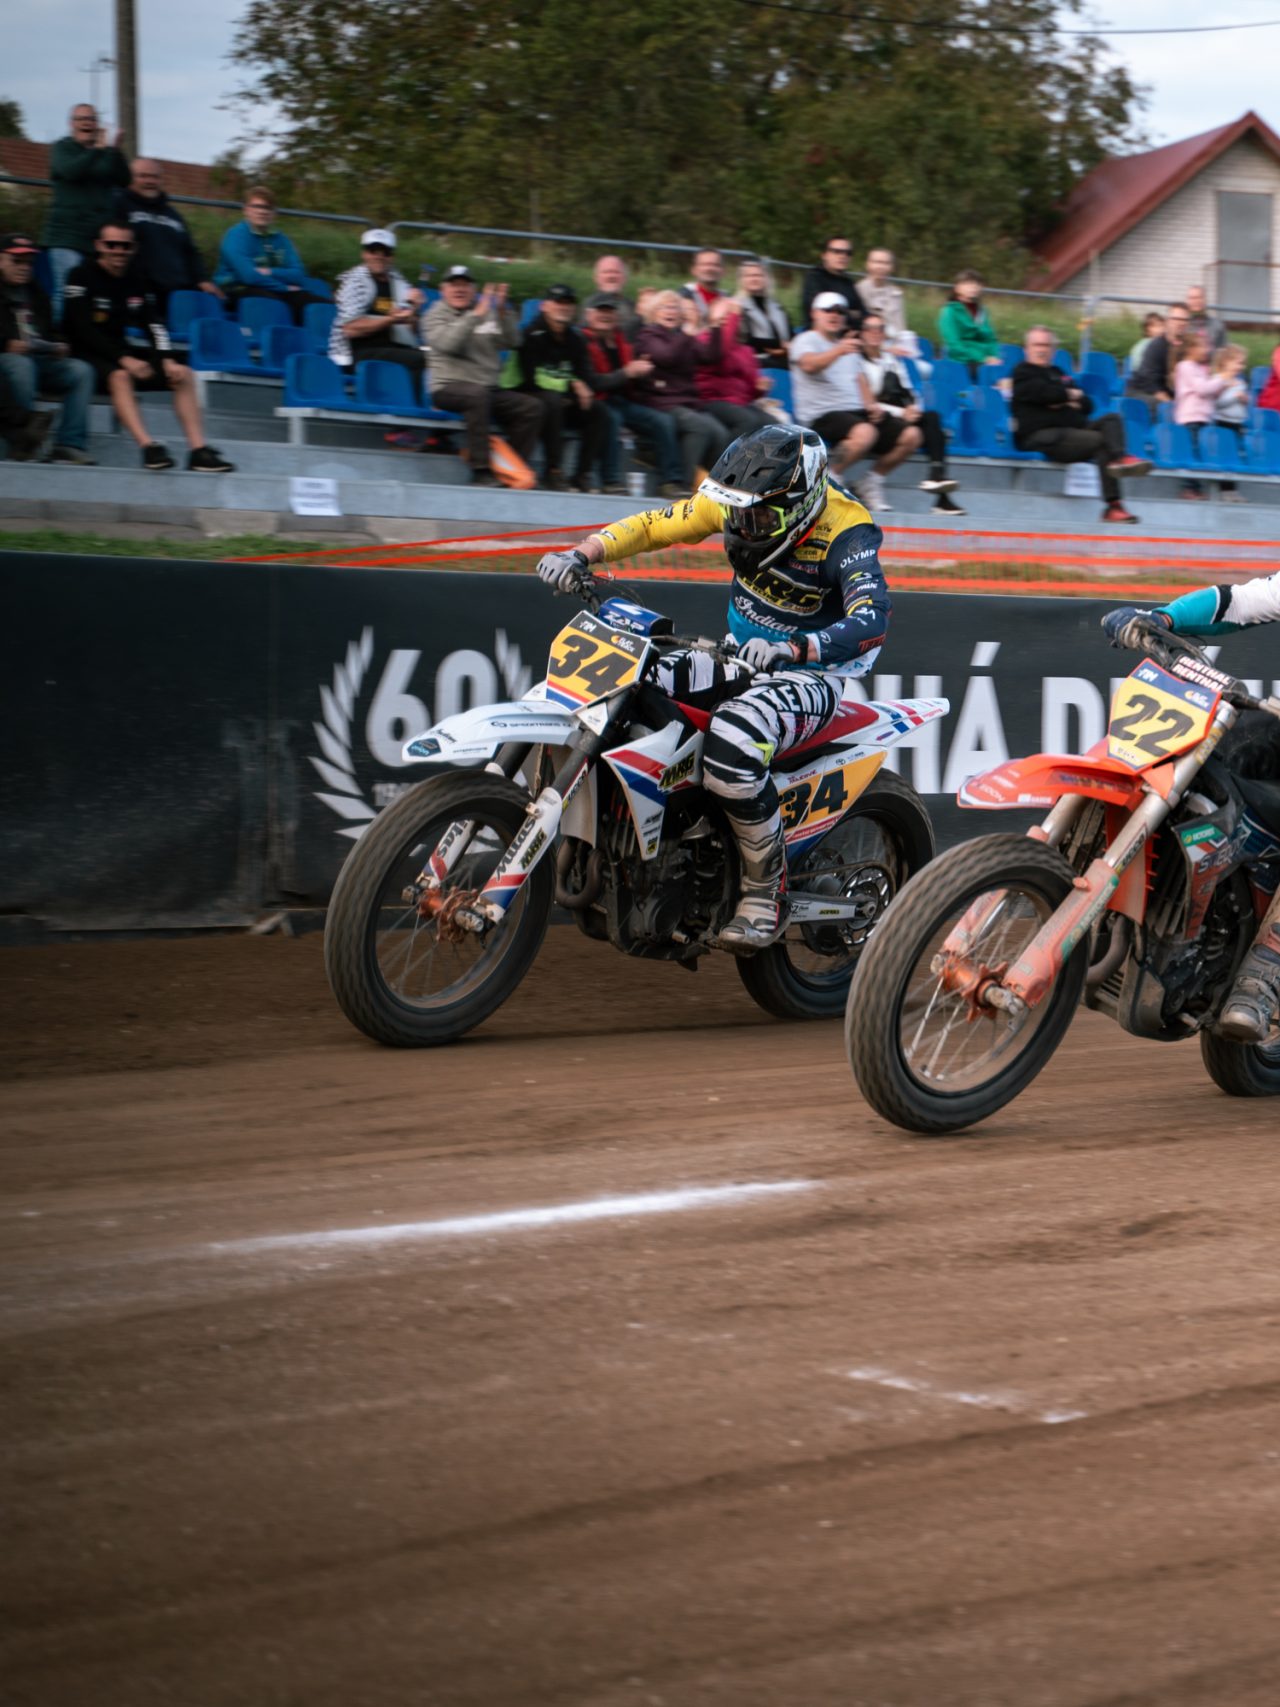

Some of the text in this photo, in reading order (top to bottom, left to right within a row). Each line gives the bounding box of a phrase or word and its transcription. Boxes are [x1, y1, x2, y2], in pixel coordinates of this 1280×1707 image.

[840, 549, 876, 569] OLYMP
[735, 596, 798, 634] Indian
[548, 634, 638, 698] 34
[1179, 655, 1231, 686] RENTHAL
[365, 649, 498, 767] 60
[845, 641, 1011, 794] HÁ
[1109, 693, 1195, 758] 22
[778, 769, 848, 831] 34
